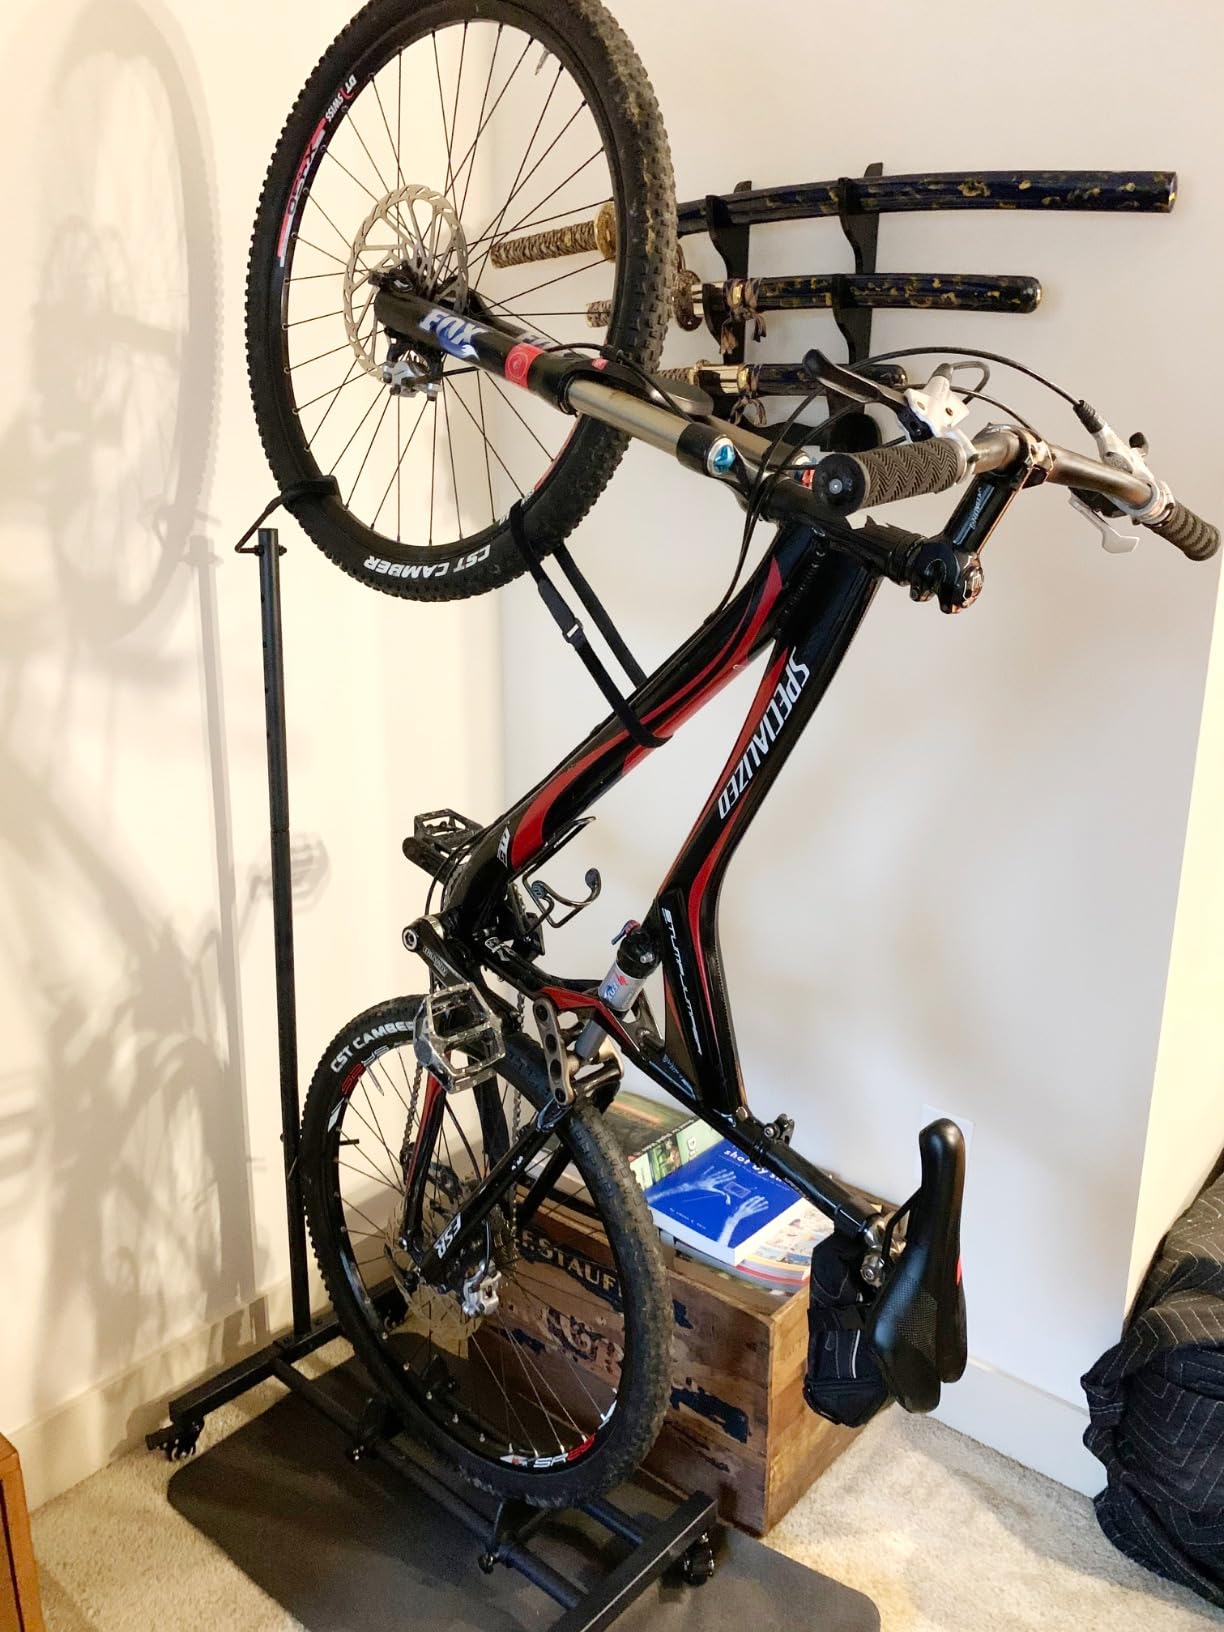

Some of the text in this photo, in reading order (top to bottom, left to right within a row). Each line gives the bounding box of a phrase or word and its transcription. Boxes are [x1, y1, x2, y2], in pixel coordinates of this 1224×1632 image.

[326, 74, 357, 122] DT SWISS
[419, 308, 489, 350] FOX
[363, 544, 491, 578] CST CAMBER
[718, 646, 810, 819] SPECIALIZED
[330, 1045, 353, 1073] CST
[433, 1212, 462, 1259] FSR
